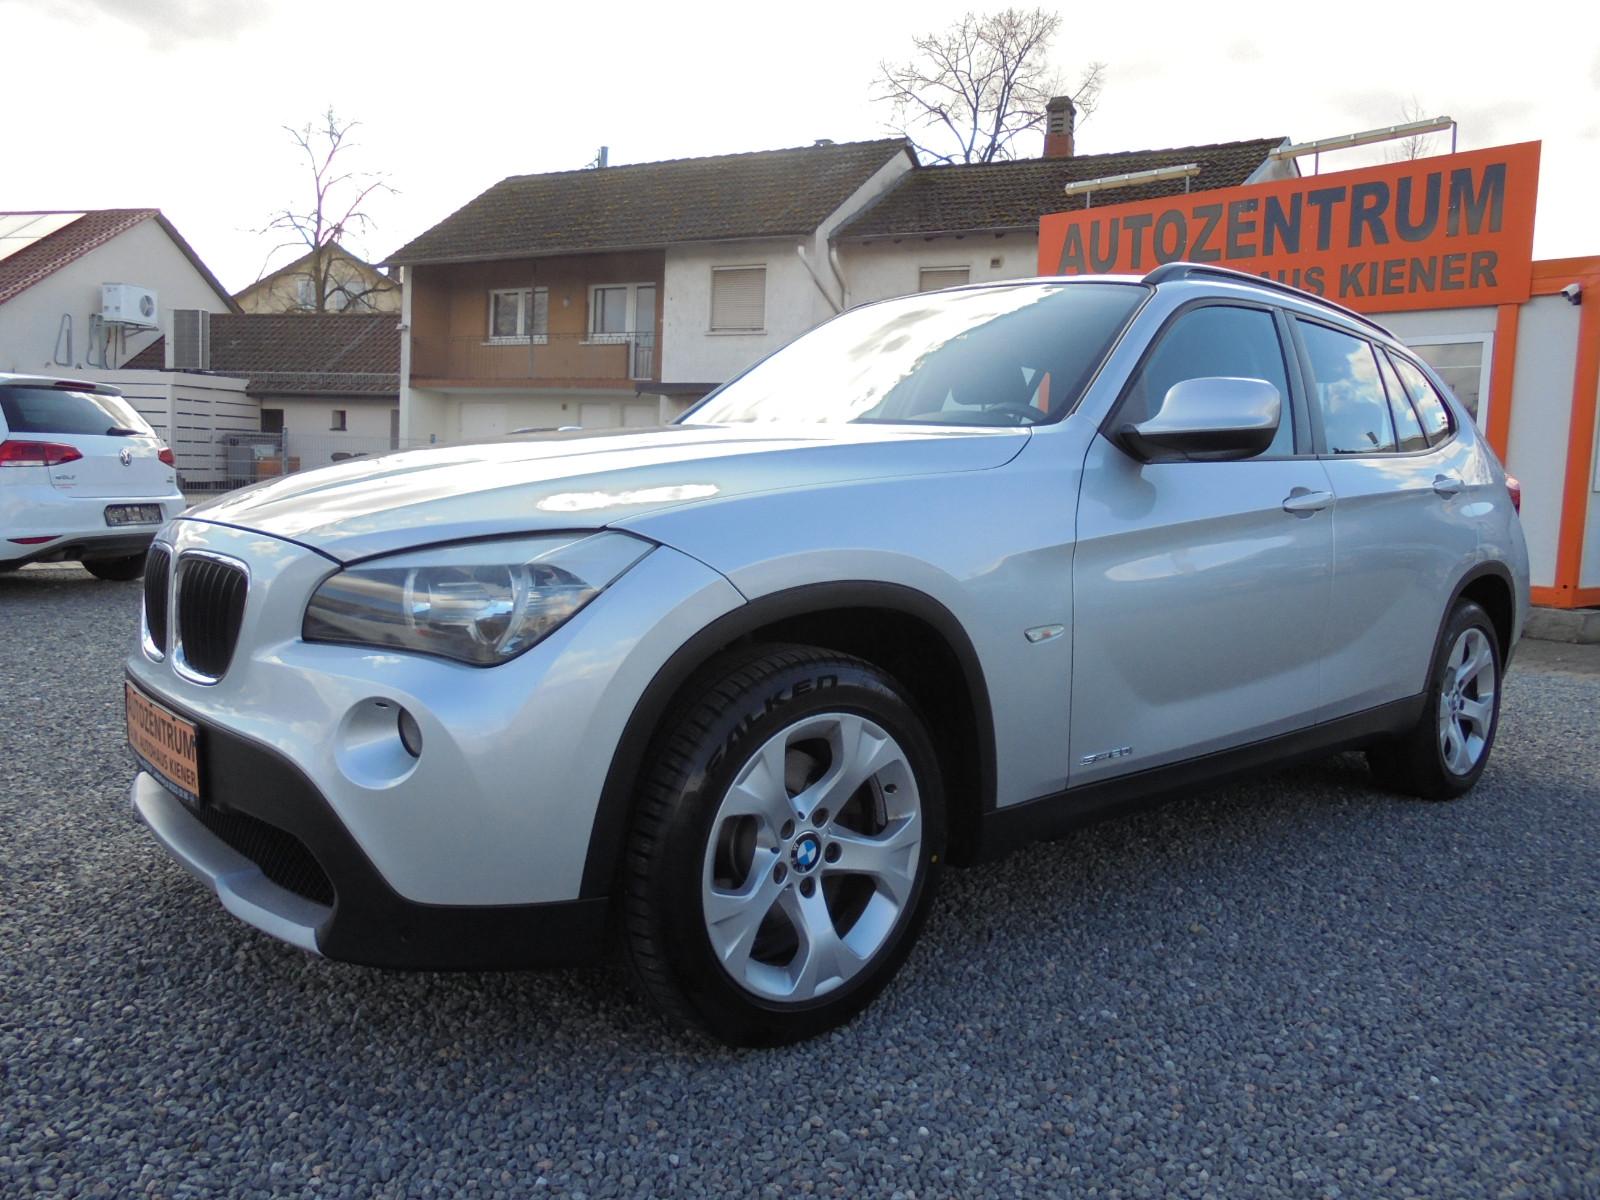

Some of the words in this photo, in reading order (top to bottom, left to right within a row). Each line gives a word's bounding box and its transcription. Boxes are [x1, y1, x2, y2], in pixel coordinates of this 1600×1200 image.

[1056, 163, 1506, 275] AUTOZENTRUM
[1338, 250, 1498, 298] KIENER
[128, 690, 197, 763] AUTOZENTRUM
[170, 758, 197, 789] KIENER
